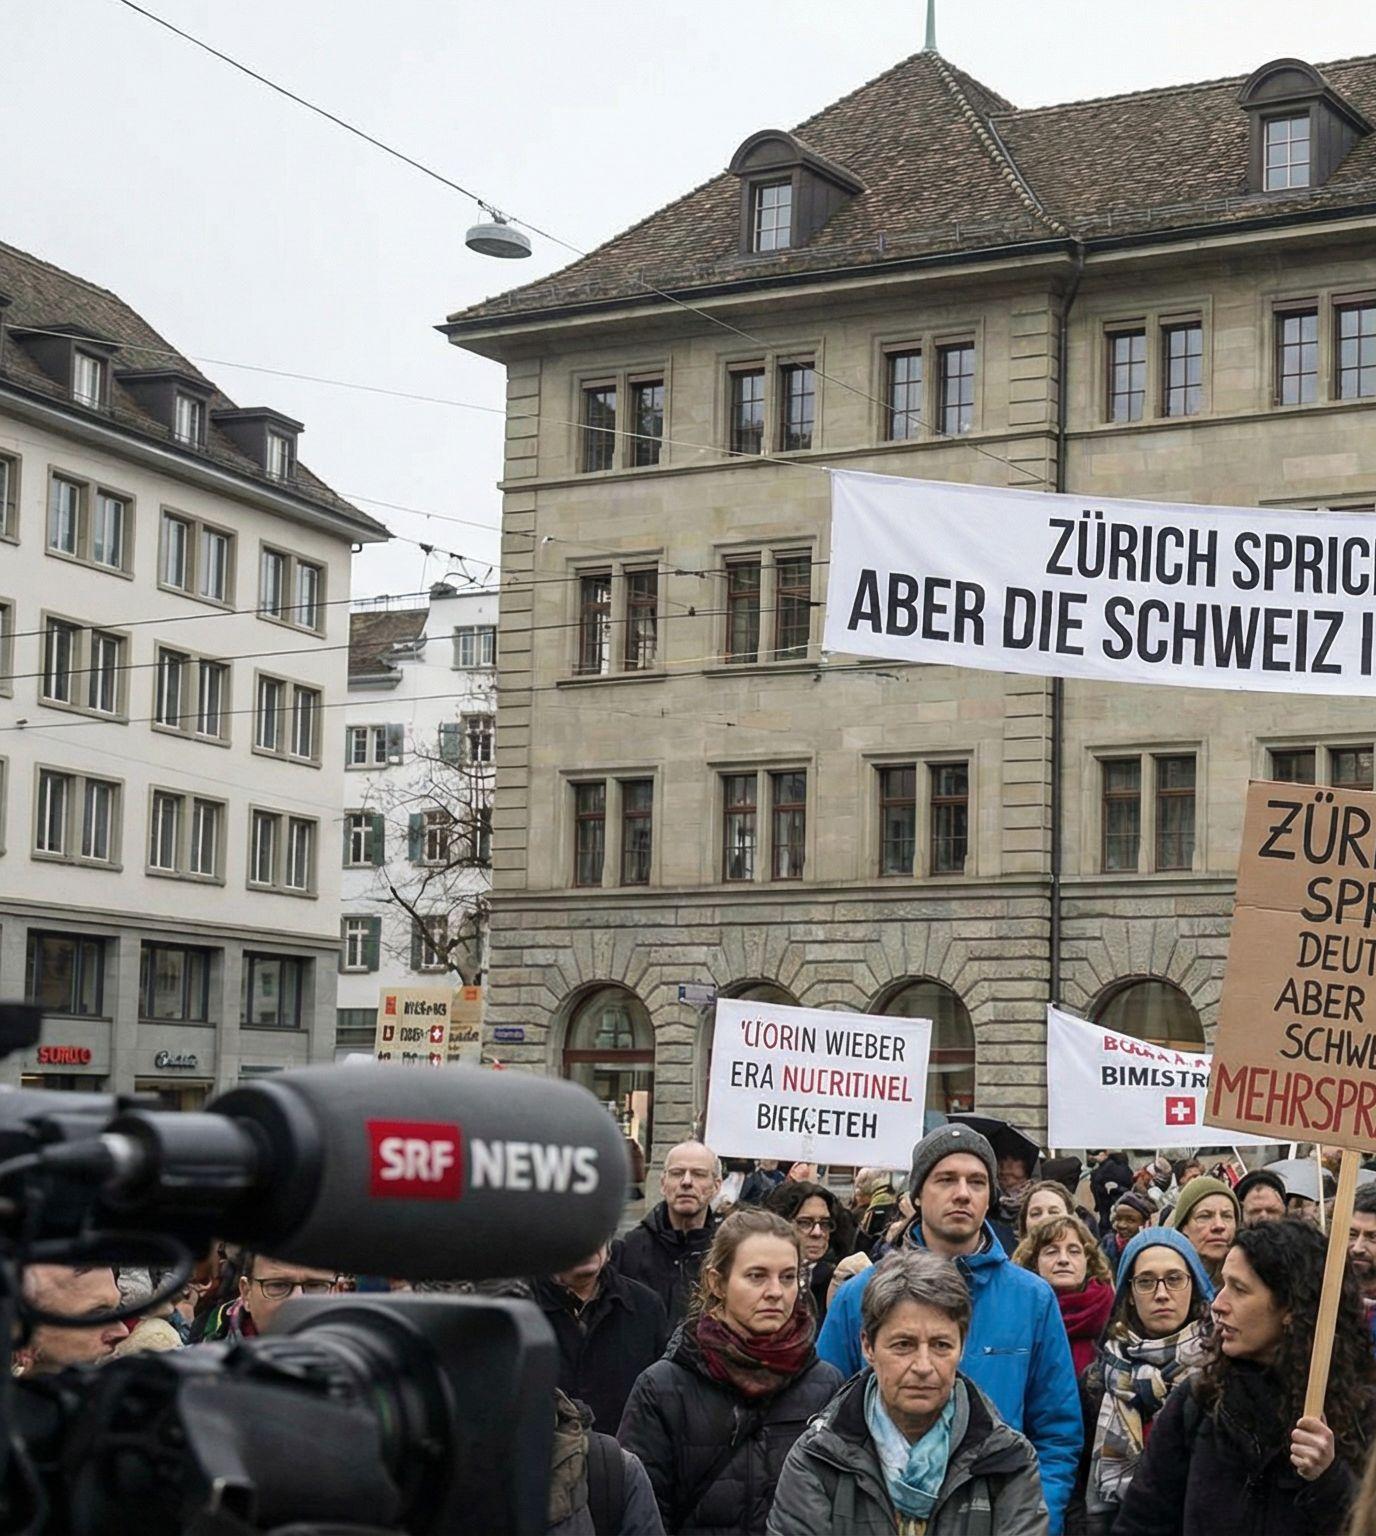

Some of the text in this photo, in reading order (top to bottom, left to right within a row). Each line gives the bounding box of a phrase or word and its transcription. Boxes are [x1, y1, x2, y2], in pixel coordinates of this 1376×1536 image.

[1046, 510, 1218, 588] ZÜRICH
[847, 569, 986, 646] ABER
[1002, 586, 1087, 656] DIE
[1101, 597, 1344, 675] SCHWEIZ
[1273, 977, 1365, 1023] ABER
[825, 1029, 905, 1062] WIEBER
[730, 1060, 774, 1090] ERA
[379, 1136, 600, 1194] SRF NEWS
